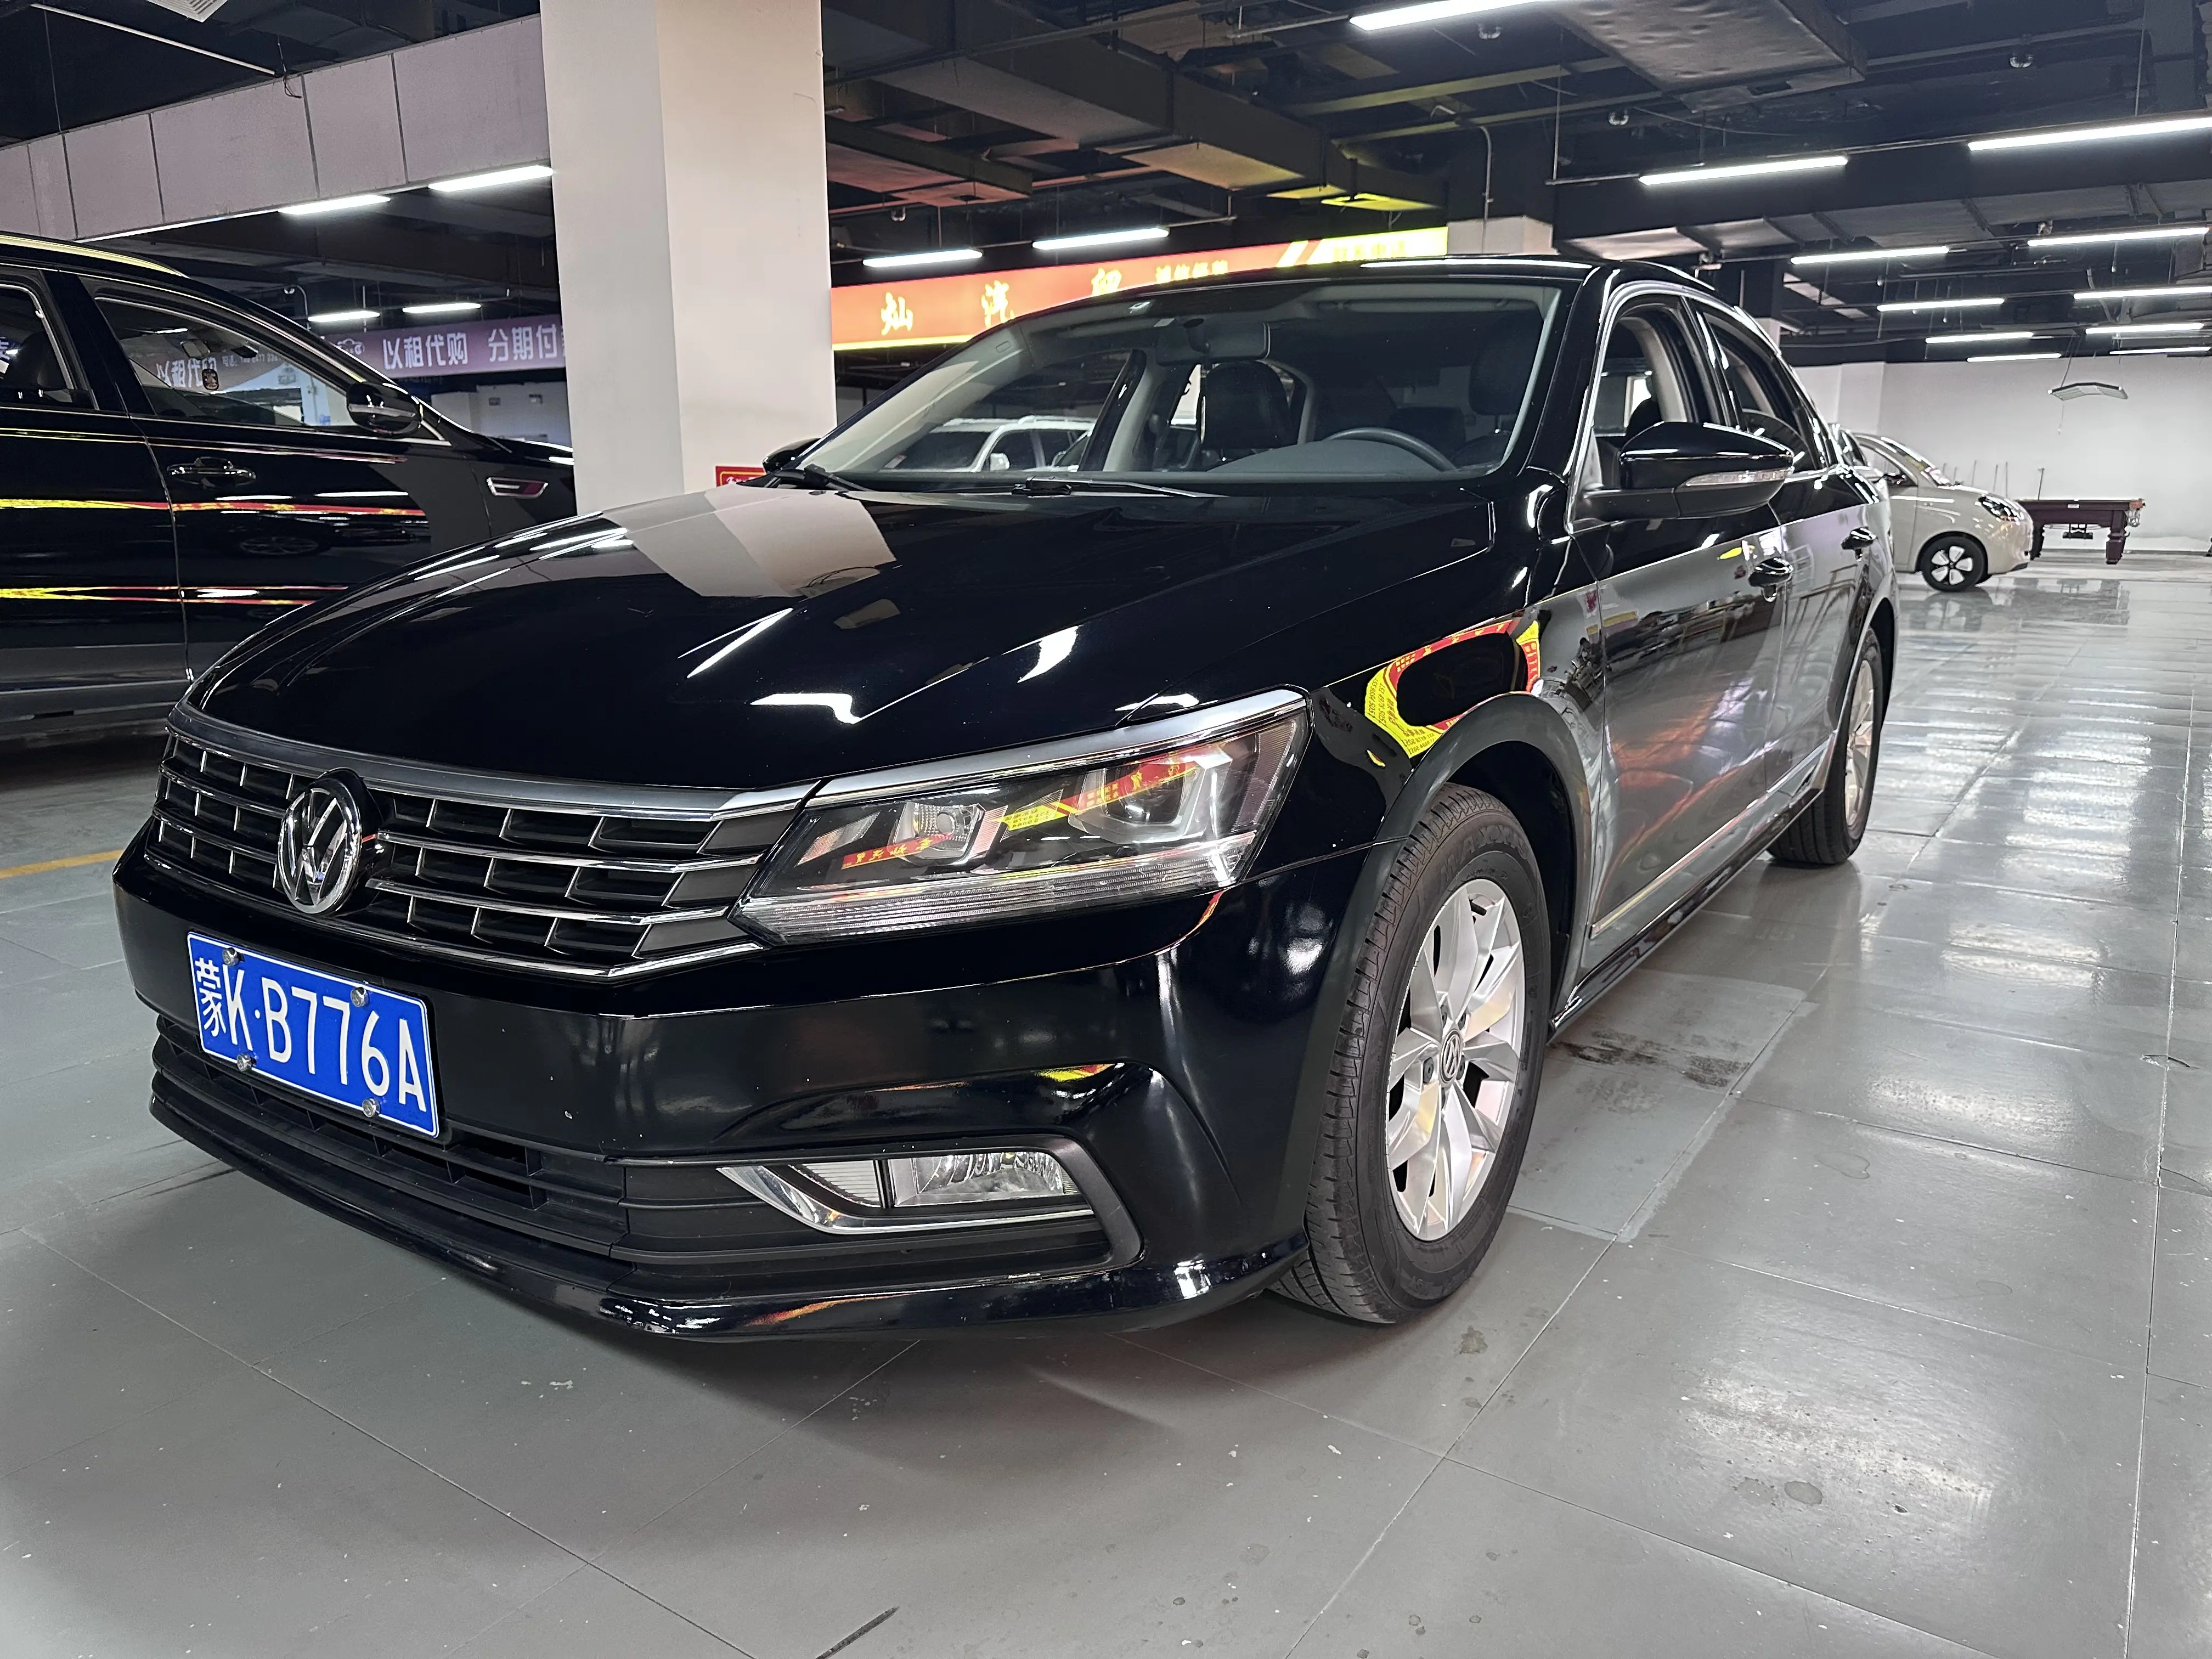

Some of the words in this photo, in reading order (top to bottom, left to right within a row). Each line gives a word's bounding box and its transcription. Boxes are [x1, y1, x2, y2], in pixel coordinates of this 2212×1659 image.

[383, 332, 468, 370] 以租代购
[488, 324, 566, 362] 分期付
[195, 957, 427, 1113] 蒙K·B776A
